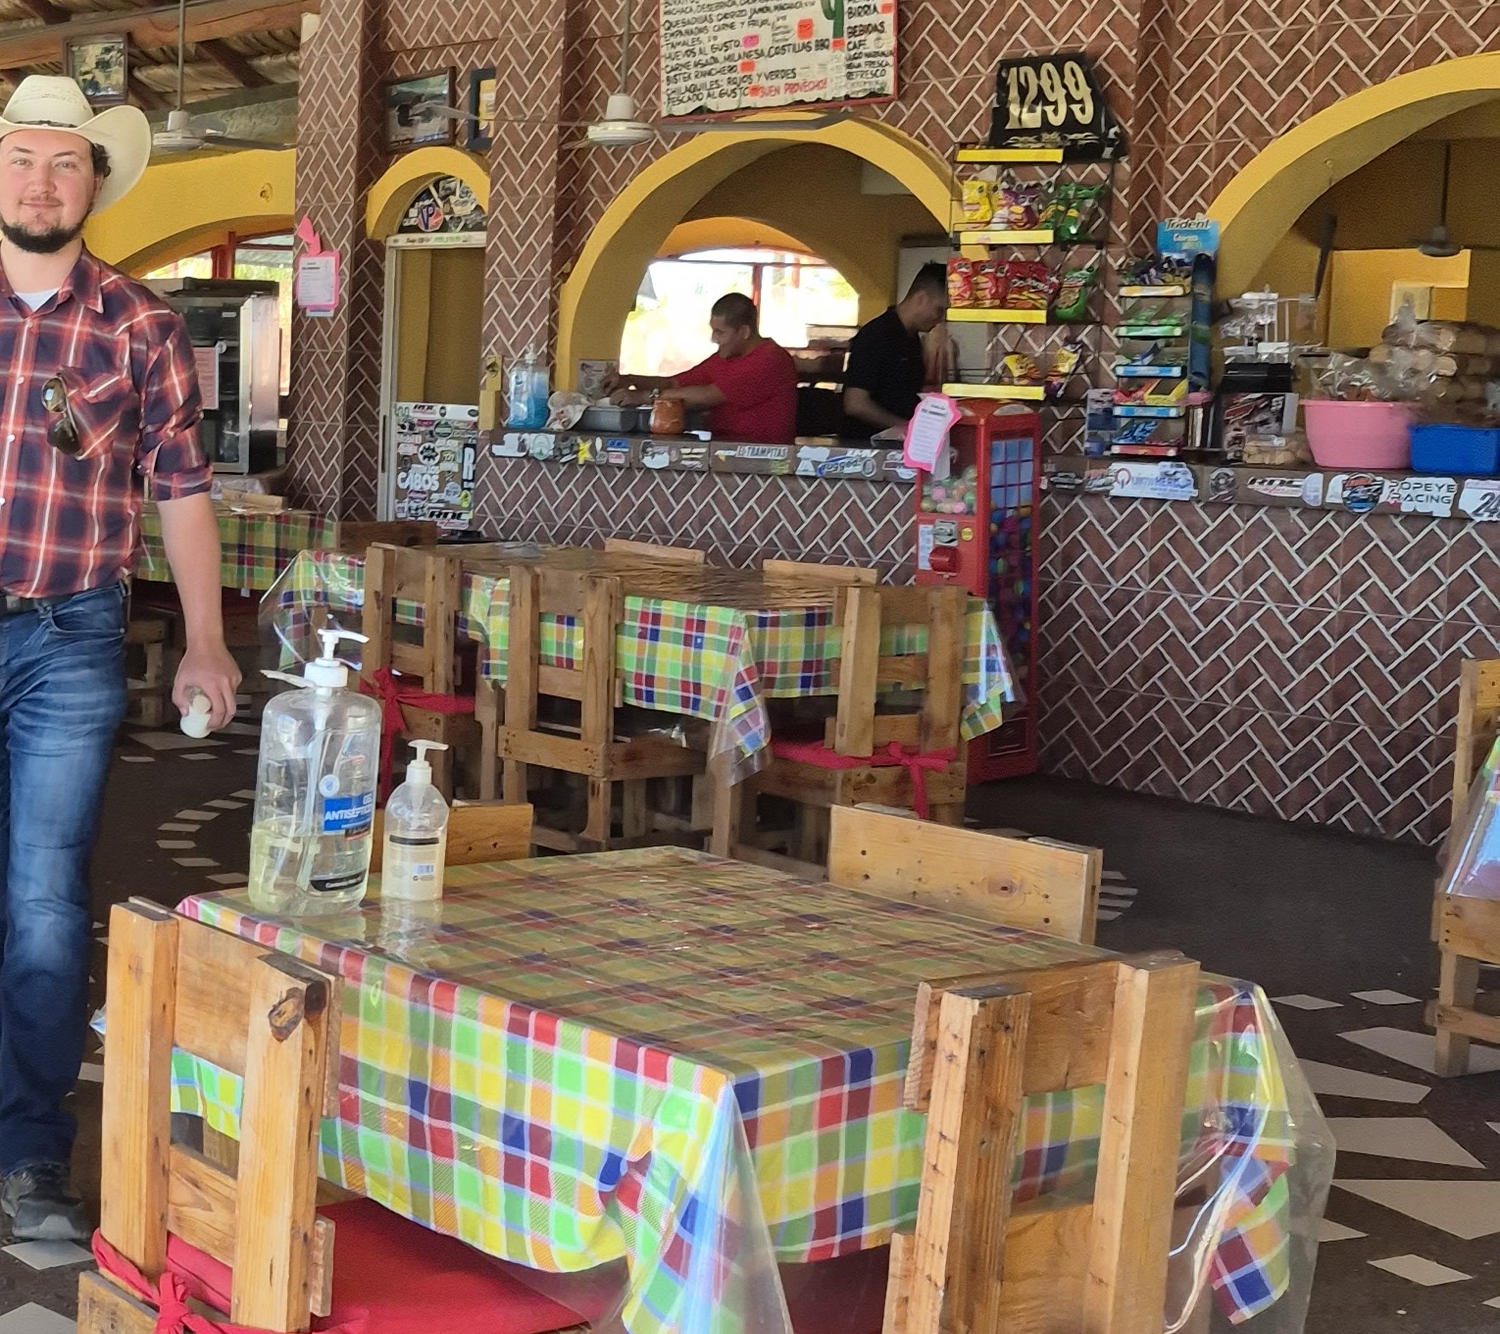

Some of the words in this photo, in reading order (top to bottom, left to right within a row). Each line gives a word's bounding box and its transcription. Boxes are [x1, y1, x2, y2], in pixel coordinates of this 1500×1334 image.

[847, 4, 880, 19] BIRRIA
[664, 47, 697, 61] HUEVOS
[699, 45, 709, 56] AL
[664, 61, 692, 74] CARNE
[768, 42, 813, 59] COSTILLAS
[764, 67, 797, 81] VERDES
[846, 68, 887, 80] REFRESCO
[666, 91, 704, 107] PESCADO
[707, 90, 719, 99] AL
[1005, 61, 1094, 130] 1299
[1165, 218, 1211, 230] Trident
[397, 471, 439, 491] CABOS
[1389, 481, 1456, 493] POPEYE
[1389, 493, 1451, 505] RACING
